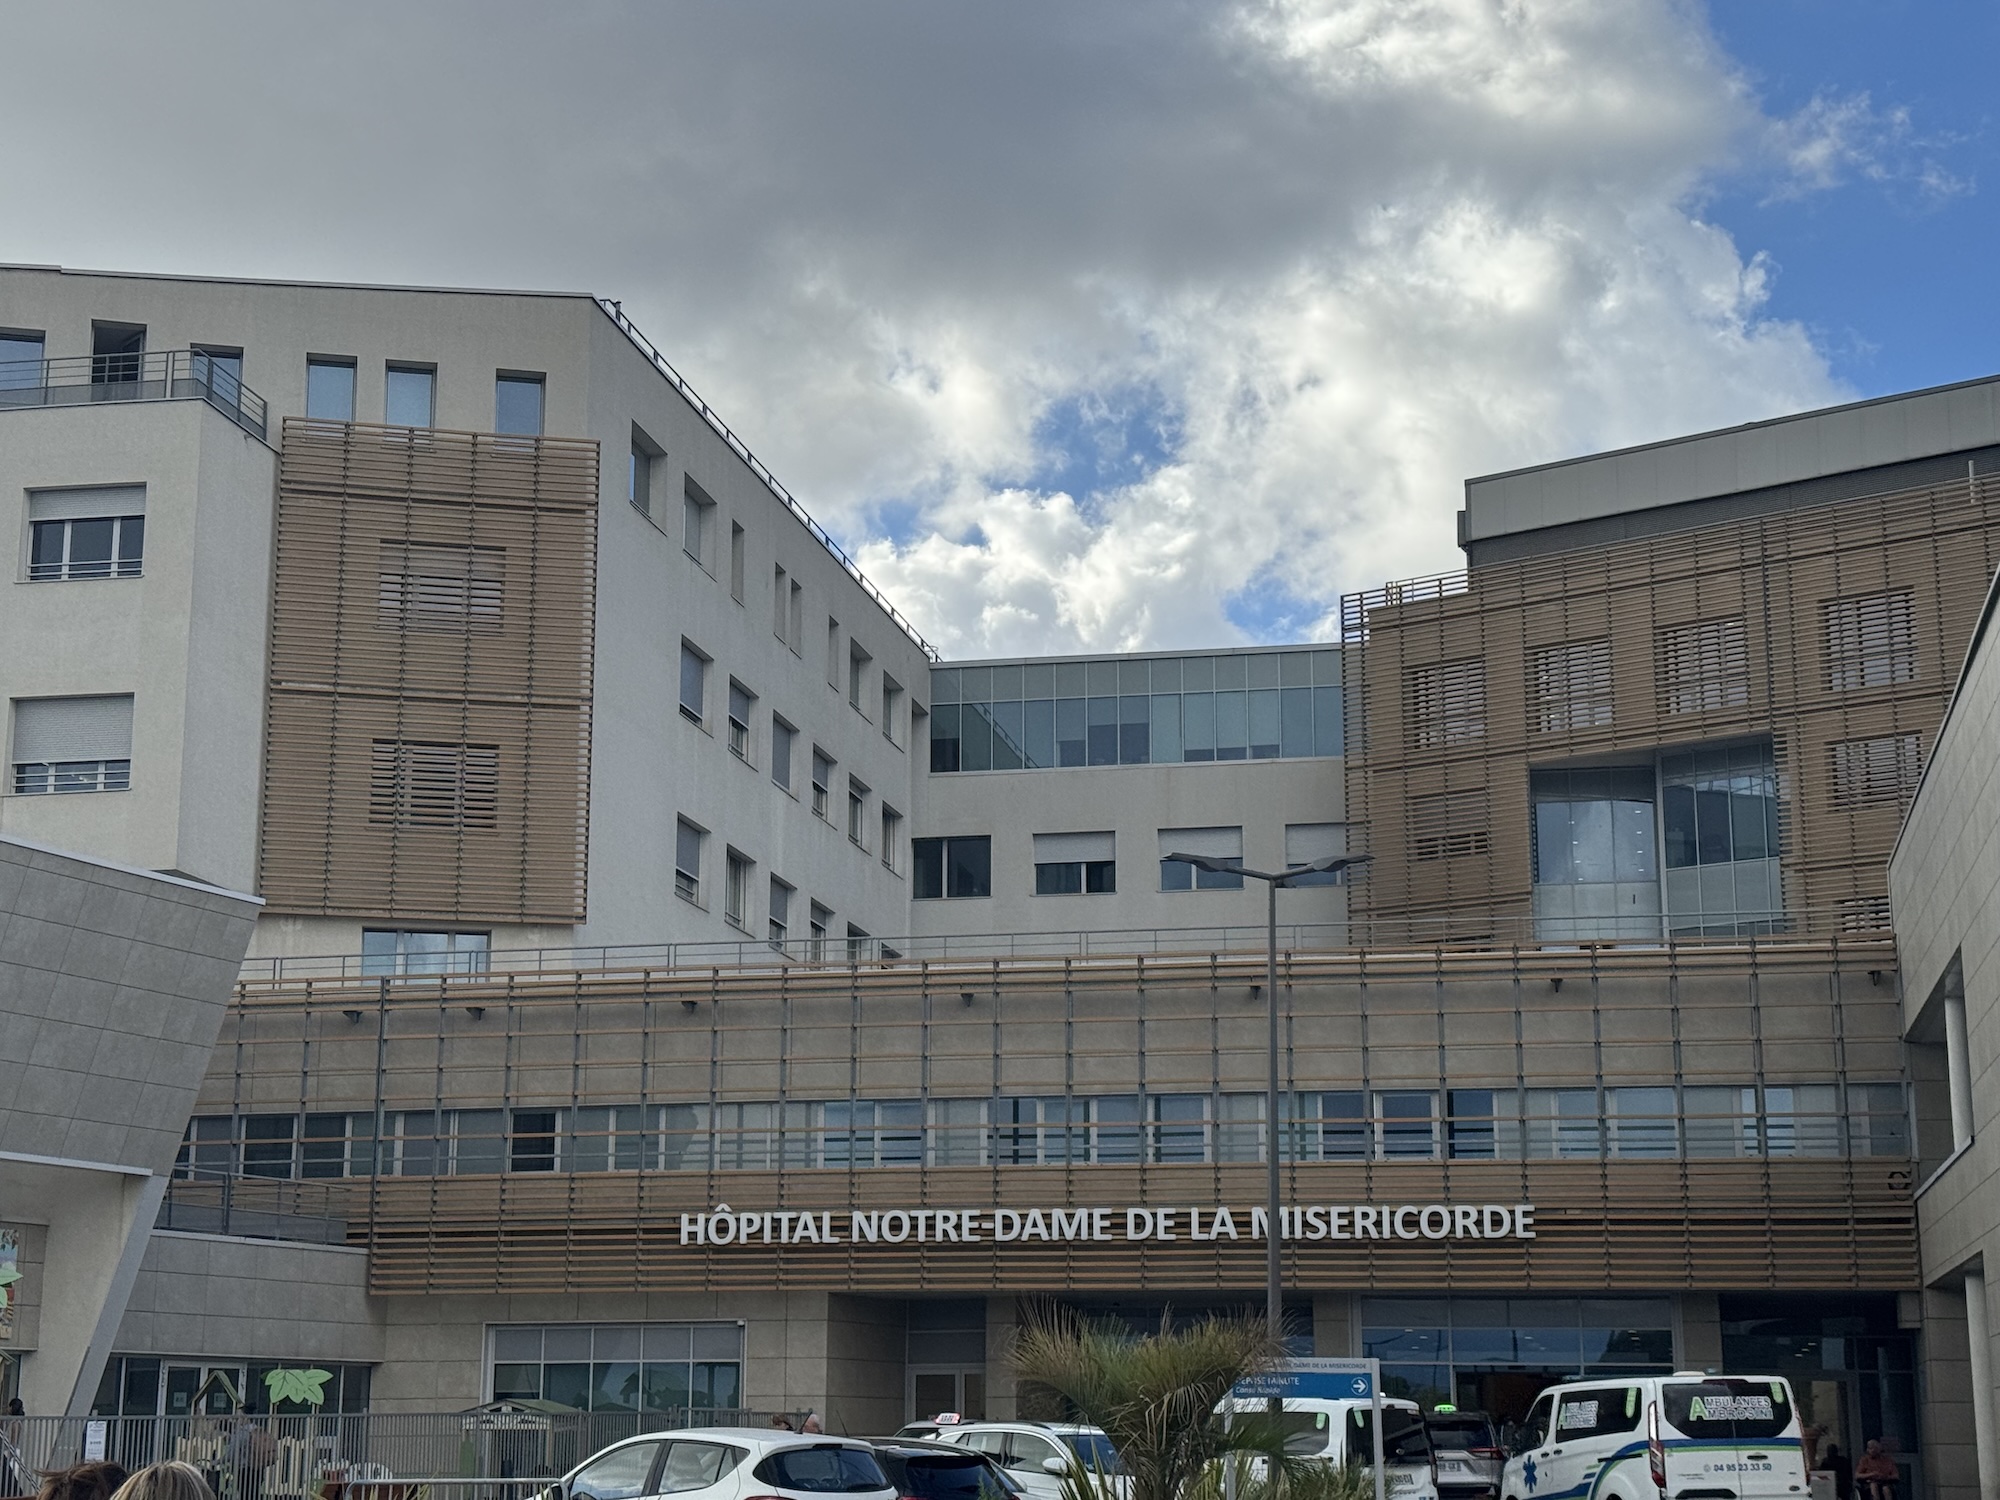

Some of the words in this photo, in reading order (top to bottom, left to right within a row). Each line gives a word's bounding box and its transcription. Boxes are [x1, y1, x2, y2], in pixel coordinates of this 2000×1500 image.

[680, 1203, 840, 1246] HÔPITAL
[851, 1207, 1113, 1244] NOTRE-DAME
[1126, 1206, 1177, 1241] DE
[1190, 1207, 1238, 1241] LA
[1251, 1204, 1537, 1241] MISERICORDE
[1689, 1396, 1772, 1409] AMBULANCES
[1750, 1463, 1760, 1471] 33
